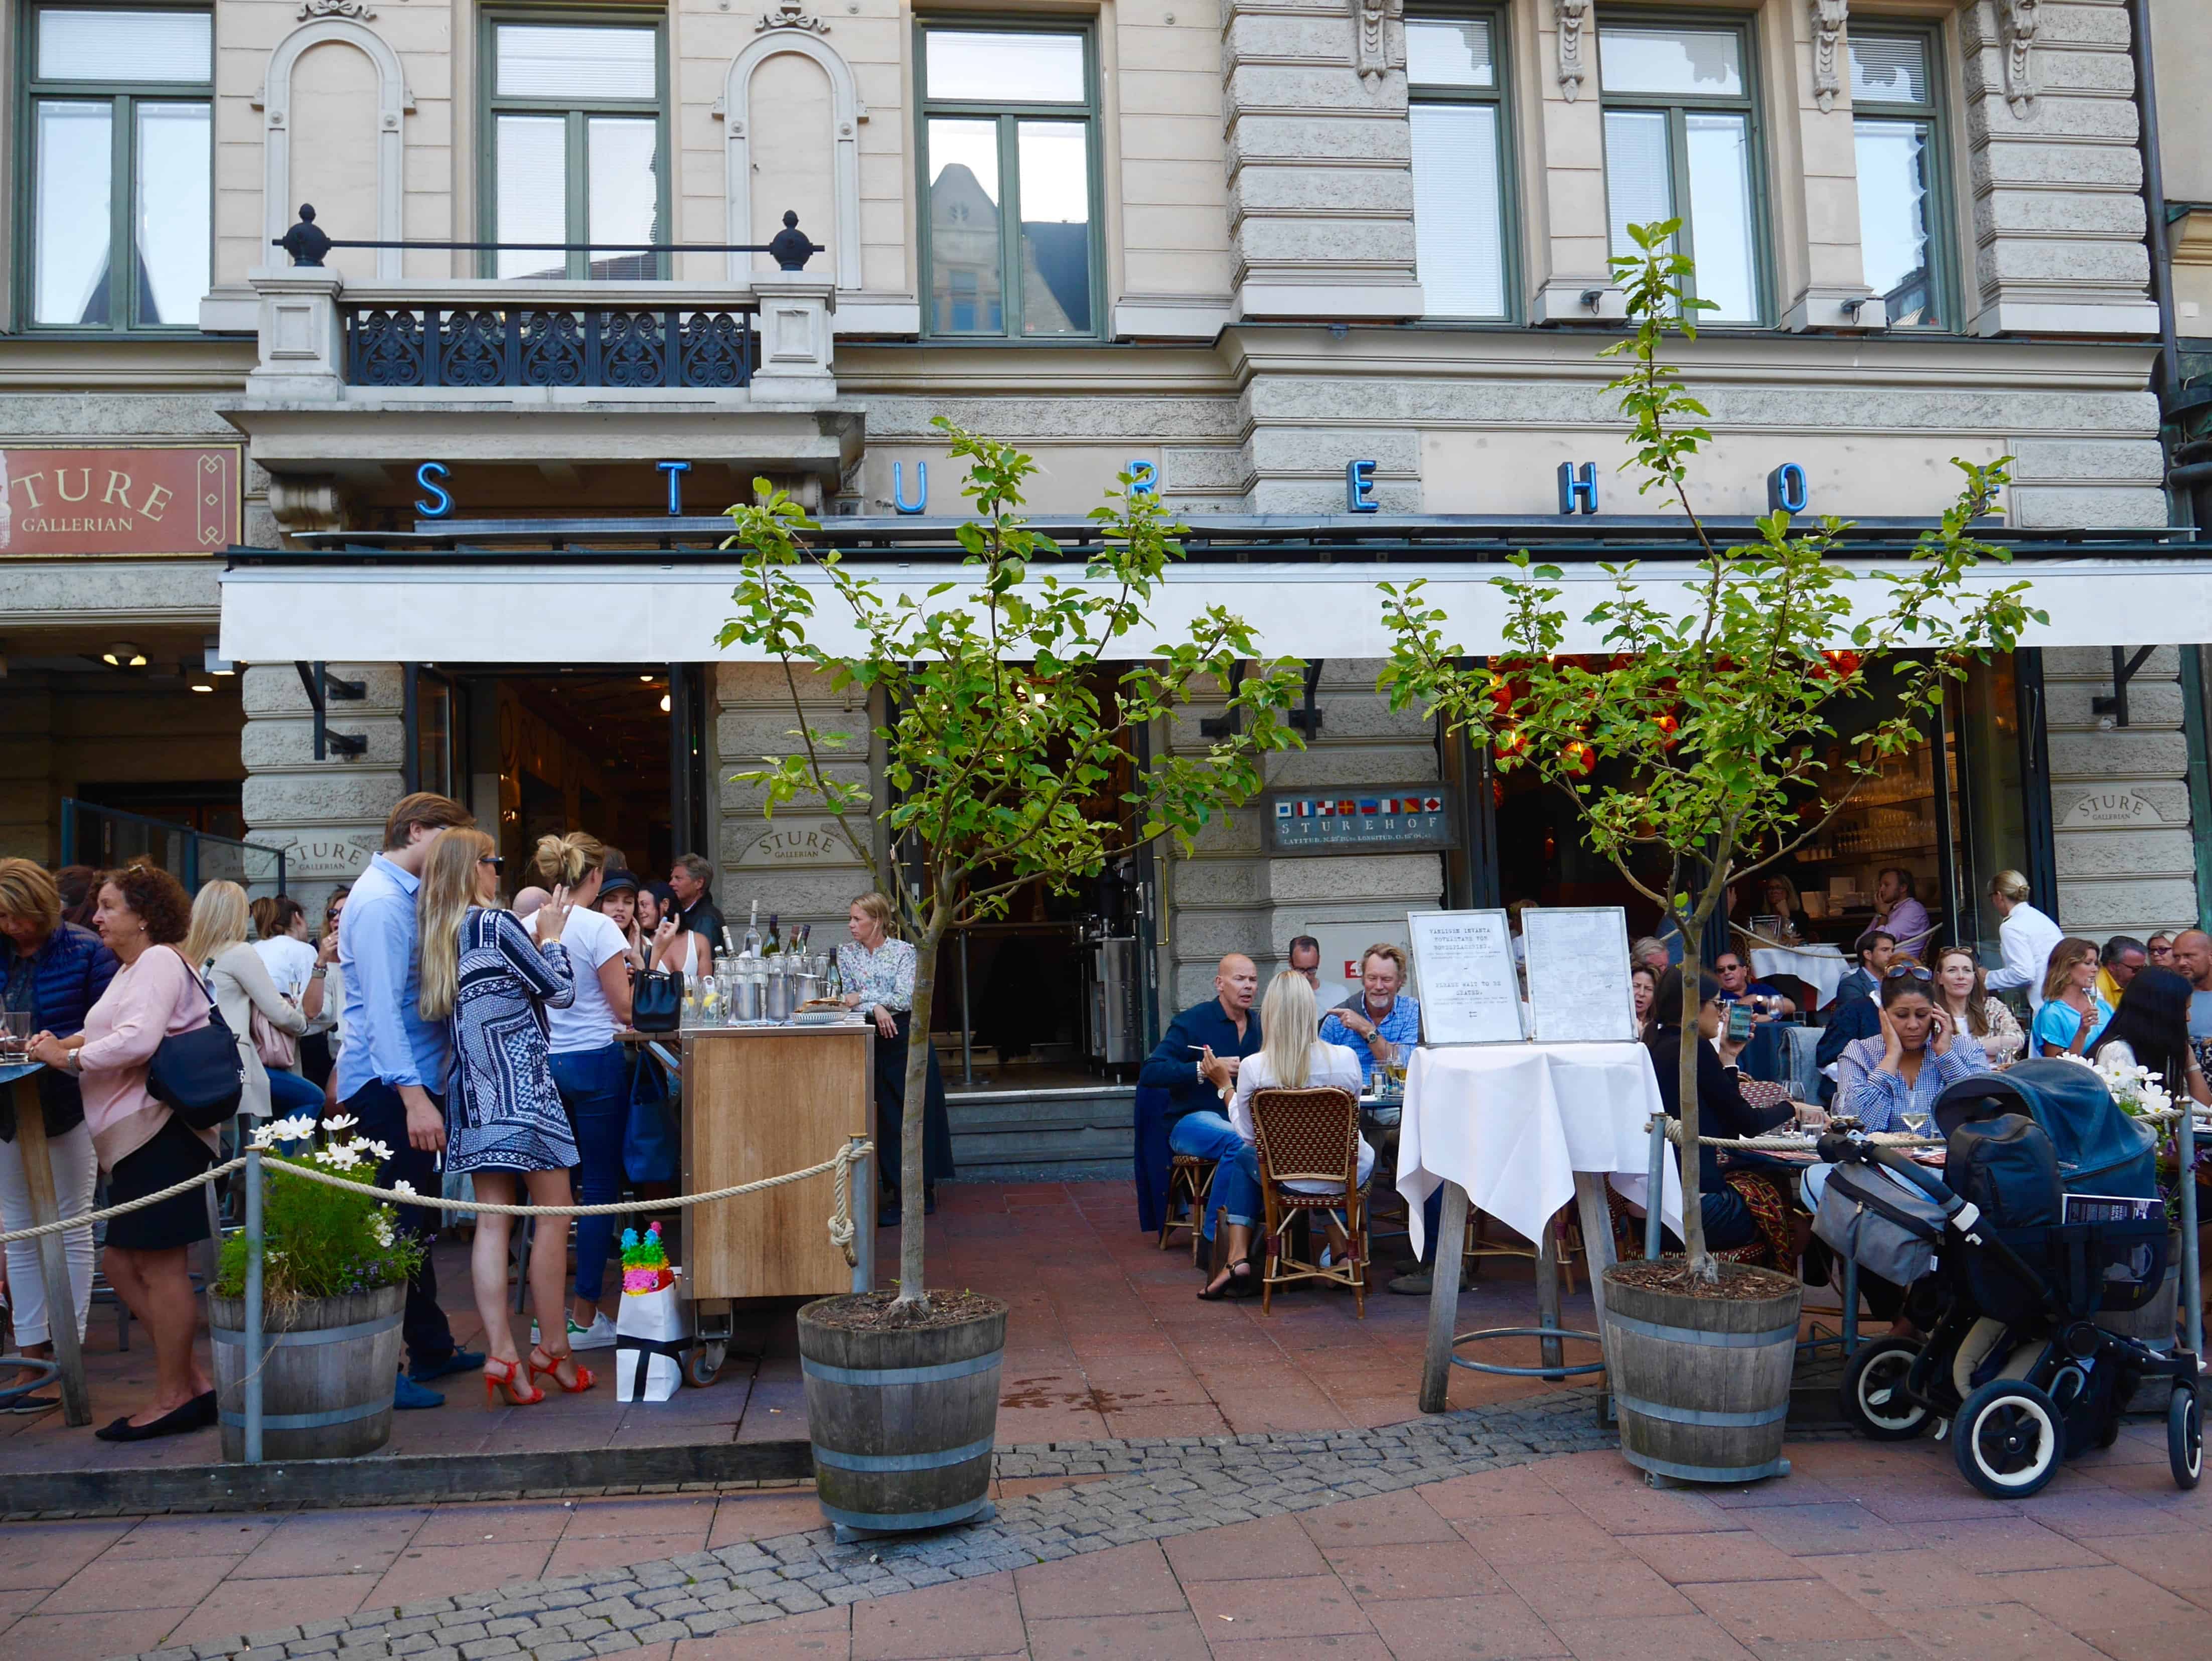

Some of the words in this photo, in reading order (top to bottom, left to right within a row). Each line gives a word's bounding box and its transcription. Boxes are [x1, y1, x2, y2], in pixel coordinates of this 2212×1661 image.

[11, 468, 174, 522] TURE
[22, 517, 133, 532] GALLERIAN
[2079, 795, 2143, 817] STURE
[1281, 817, 1437, 834] STUREHOF
[759, 831, 834, 855] STURE
[285, 843, 362, 866] STURE
